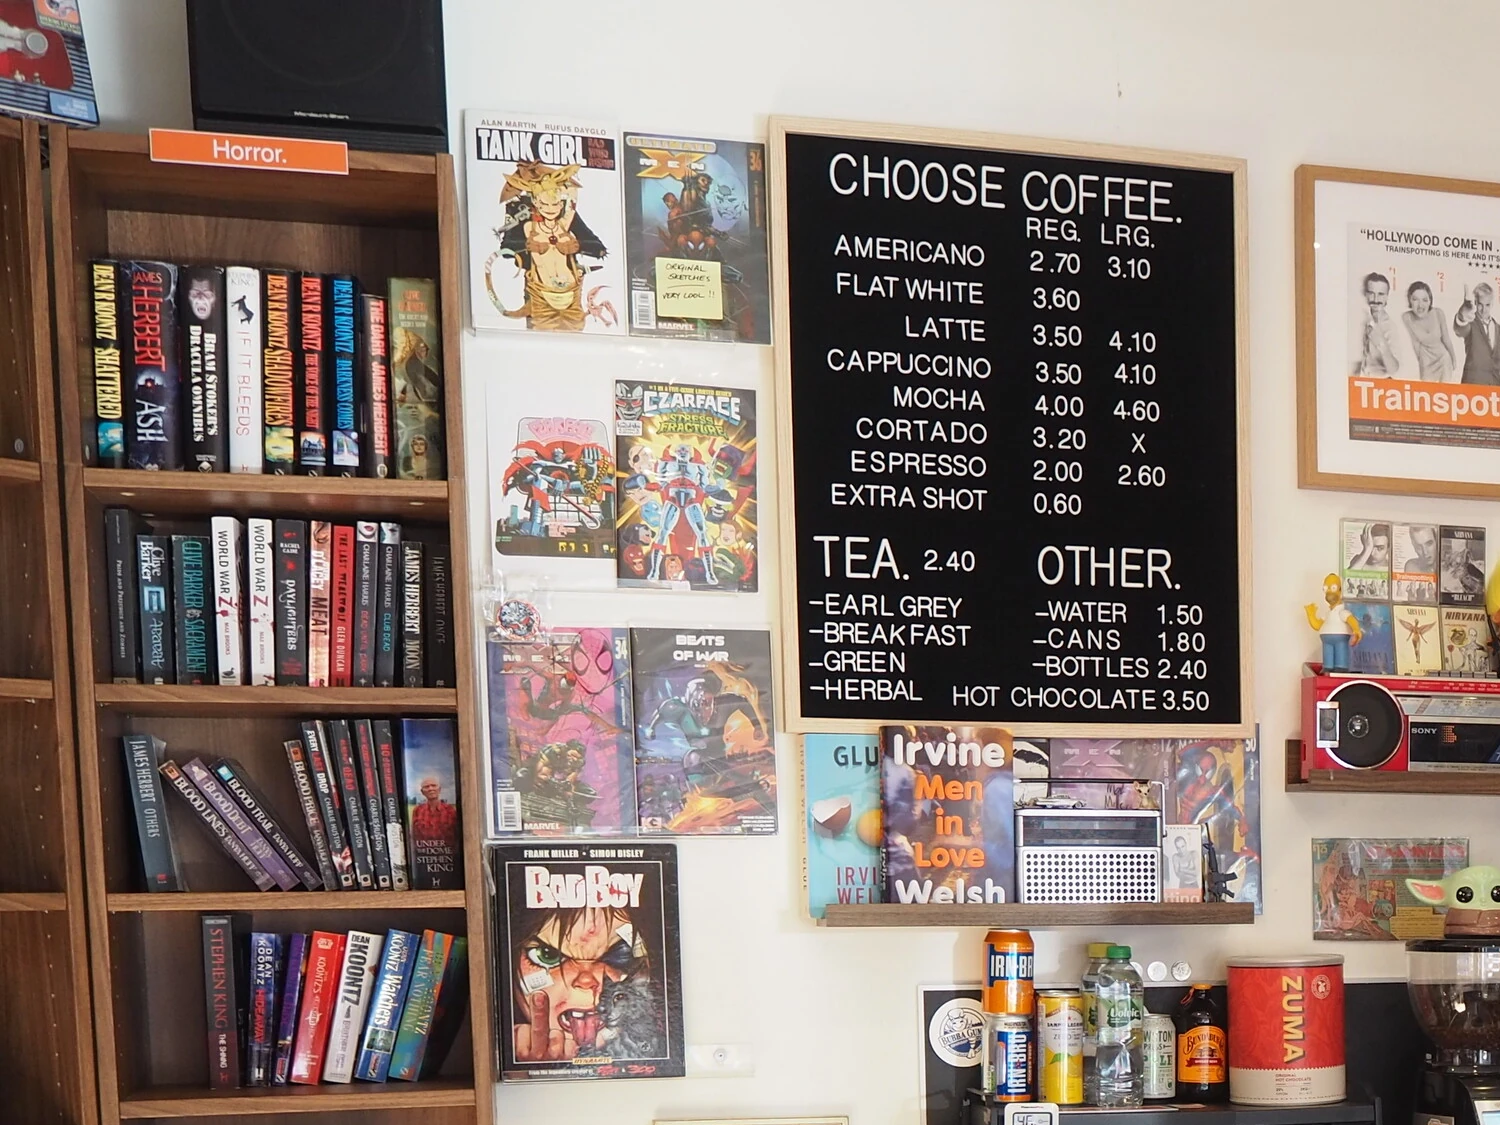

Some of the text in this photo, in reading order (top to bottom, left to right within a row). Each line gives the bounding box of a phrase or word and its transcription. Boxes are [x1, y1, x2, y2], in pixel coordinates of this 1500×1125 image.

[505, 121, 537, 129] MARTIN
[544, 124, 572, 132] RUFUS
[574, 126, 606, 135] DAYGLO
[212, 136, 288, 165] Horror.
[478, 130, 588, 166] TANK GIRL
[828, 153, 1183, 224] CHOOSE COFFEE.
[1026, 218, 1156, 248] REG. LRG.
[1443, 237, 1478, 250] COME
[1481, 240, 1493, 252] IN
[666, 263, 706, 272] ORIGINAL
[834, 235, 1151, 280] AMERICANO 2.70 3.10
[1385, 245, 1441, 257] TRAINSPOTTING
[1443, 249, 1450, 258] IS
[1452, 251, 1470, 260] HERE
[1472, 252, 1486, 261] AND
[1488, 254, 1500, 263] IT'S
[132, 272, 162, 283] JAMES
[668, 273, 711, 282] SKETCHES
[662, 290, 681, 300] VERY
[836, 273, 1081, 311] FLAT WHITE 3.60
[132, 286, 166, 371] HERBERT
[905, 316, 1156, 353] LATTE 3.50 4.10
[827, 349, 1156, 385] CAPPUCCINO 3.50 4.10
[190, 325, 204, 442] DRACULA OMNIBUS
[204, 333, 218, 436] BRAM STOKER'S
[643, 391, 741, 420] CZARFACE
[893, 387, 1160, 423] MOCHA 4.00 4.60
[135, 399, 168, 442] ASH
[657, 421, 729, 440] FRACTURE
[670, 414, 715, 424] STRESS
[856, 418, 1146, 453] CORTADO 3.20 X
[850, 451, 1166, 487] ESPRESSO 2.00 2.60
[831, 484, 1082, 516] EXTRA SHOT 0.60
[218, 530, 232, 607] WORLD WAR Z
[813, 535, 976, 581] TEA. 2.40
[1037, 546, 1182, 590] OTHER.
[900, 598, 962, 619] GREY
[1156, 605, 1203, 625] 1.50
[1445, 611, 1486, 622] NIRVANA
[676, 635, 724, 646] BEATS
[1158, 632, 1206, 653] 1.80
[673, 651, 729, 662] OF WAR
[1157, 660, 1207, 681] 2.40
[952, 686, 1210, 712] HOT CHOCOLATE 3.50
[1411, 727, 1437, 735] SONY
[893, 734, 1005, 767] Irvine
[915, 776, 983, 801] Men
[936, 811, 963, 835] in
[524, 850, 644, 858] FRANK MILLER SIMON BISLEY
[915, 845, 985, 869] Love
[894, 878, 1005, 904] Welsh
[341, 943, 368, 1006] KOONTZ
[1281, 975, 1305, 1063] ZUMA
